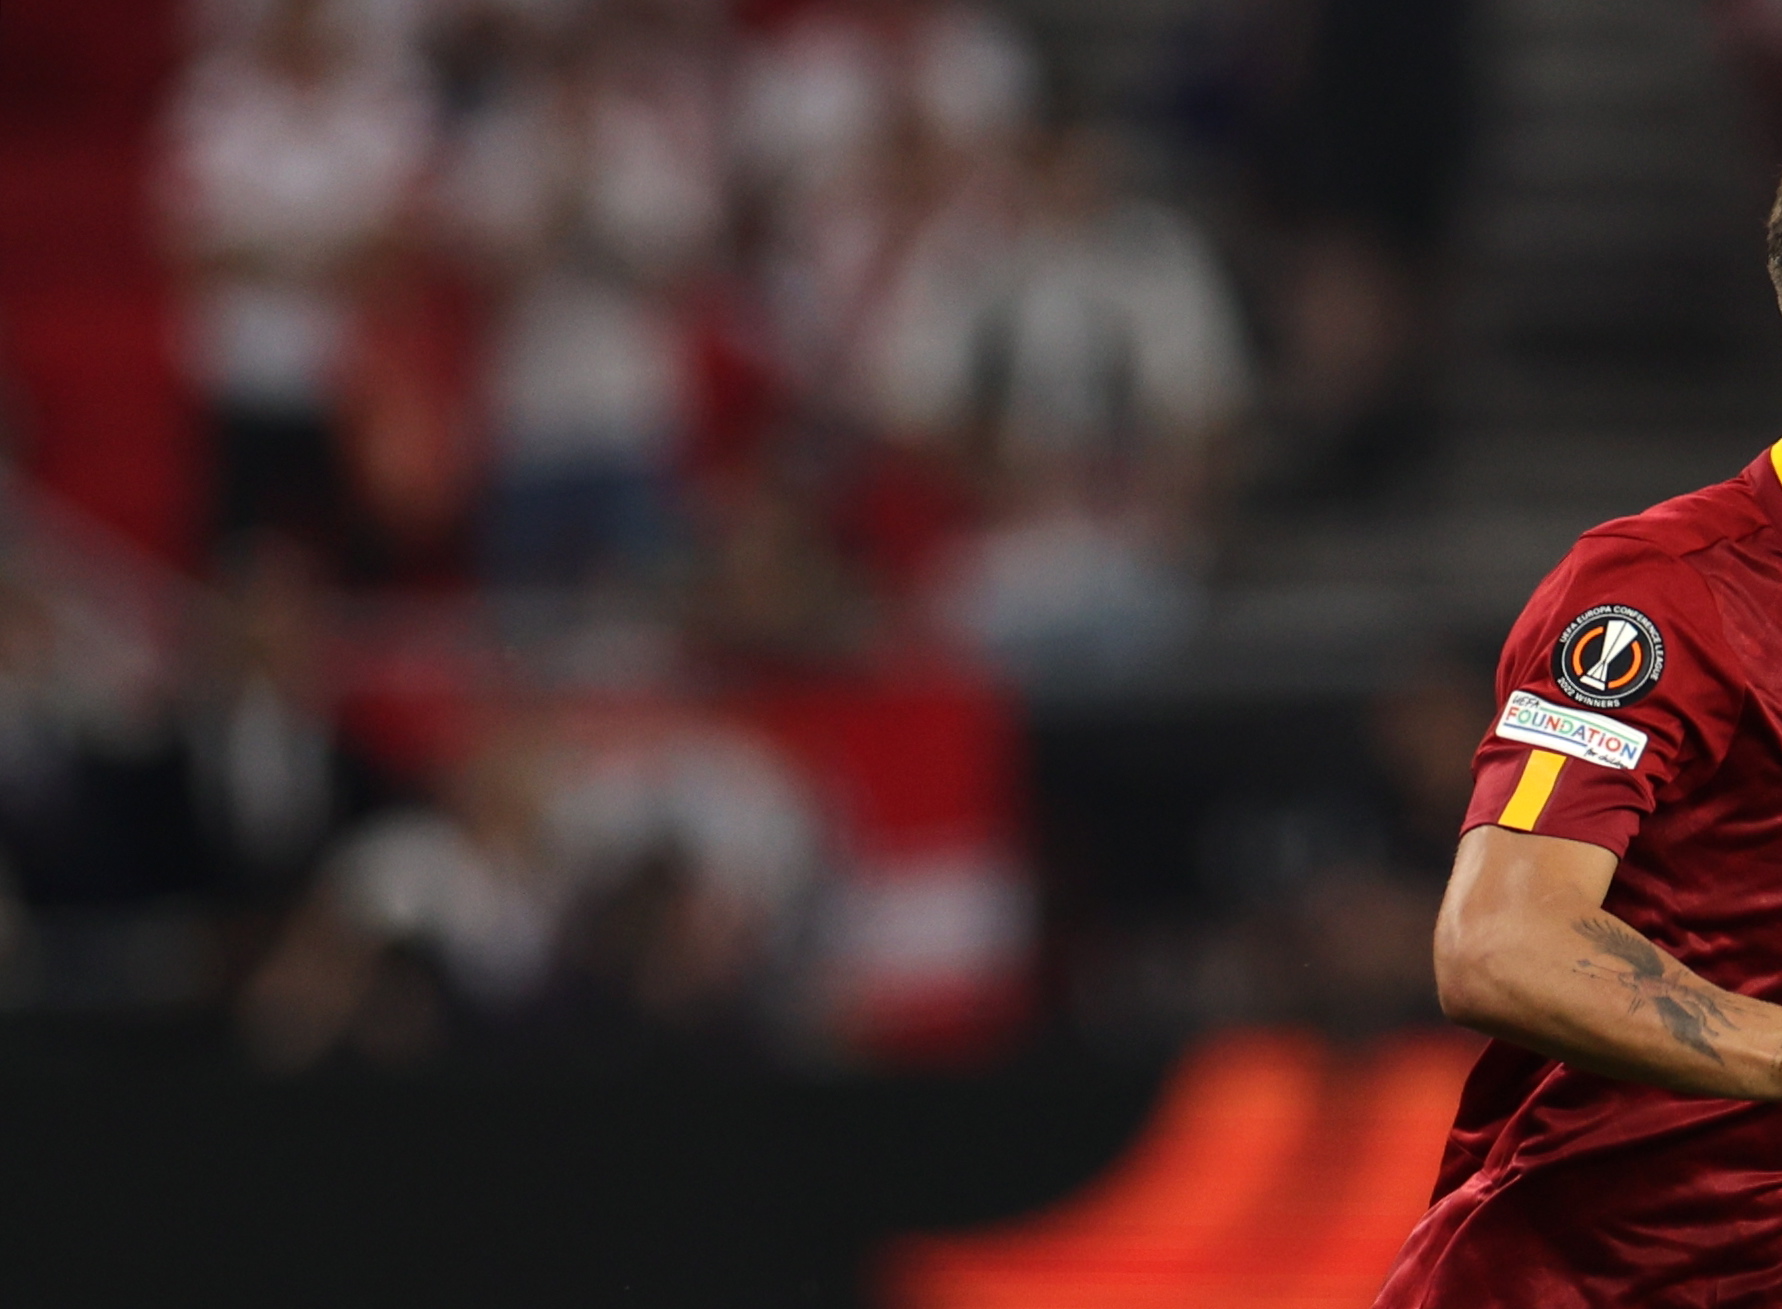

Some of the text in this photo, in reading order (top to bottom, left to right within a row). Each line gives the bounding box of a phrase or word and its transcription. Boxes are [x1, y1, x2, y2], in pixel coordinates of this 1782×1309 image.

[1560, 605, 1664, 682] UEFA EUROPA CONFERENCE LEAGUE
[1574, 692, 1621, 708] WINNERS
[1505, 706, 1638, 760] FOUNDATION
